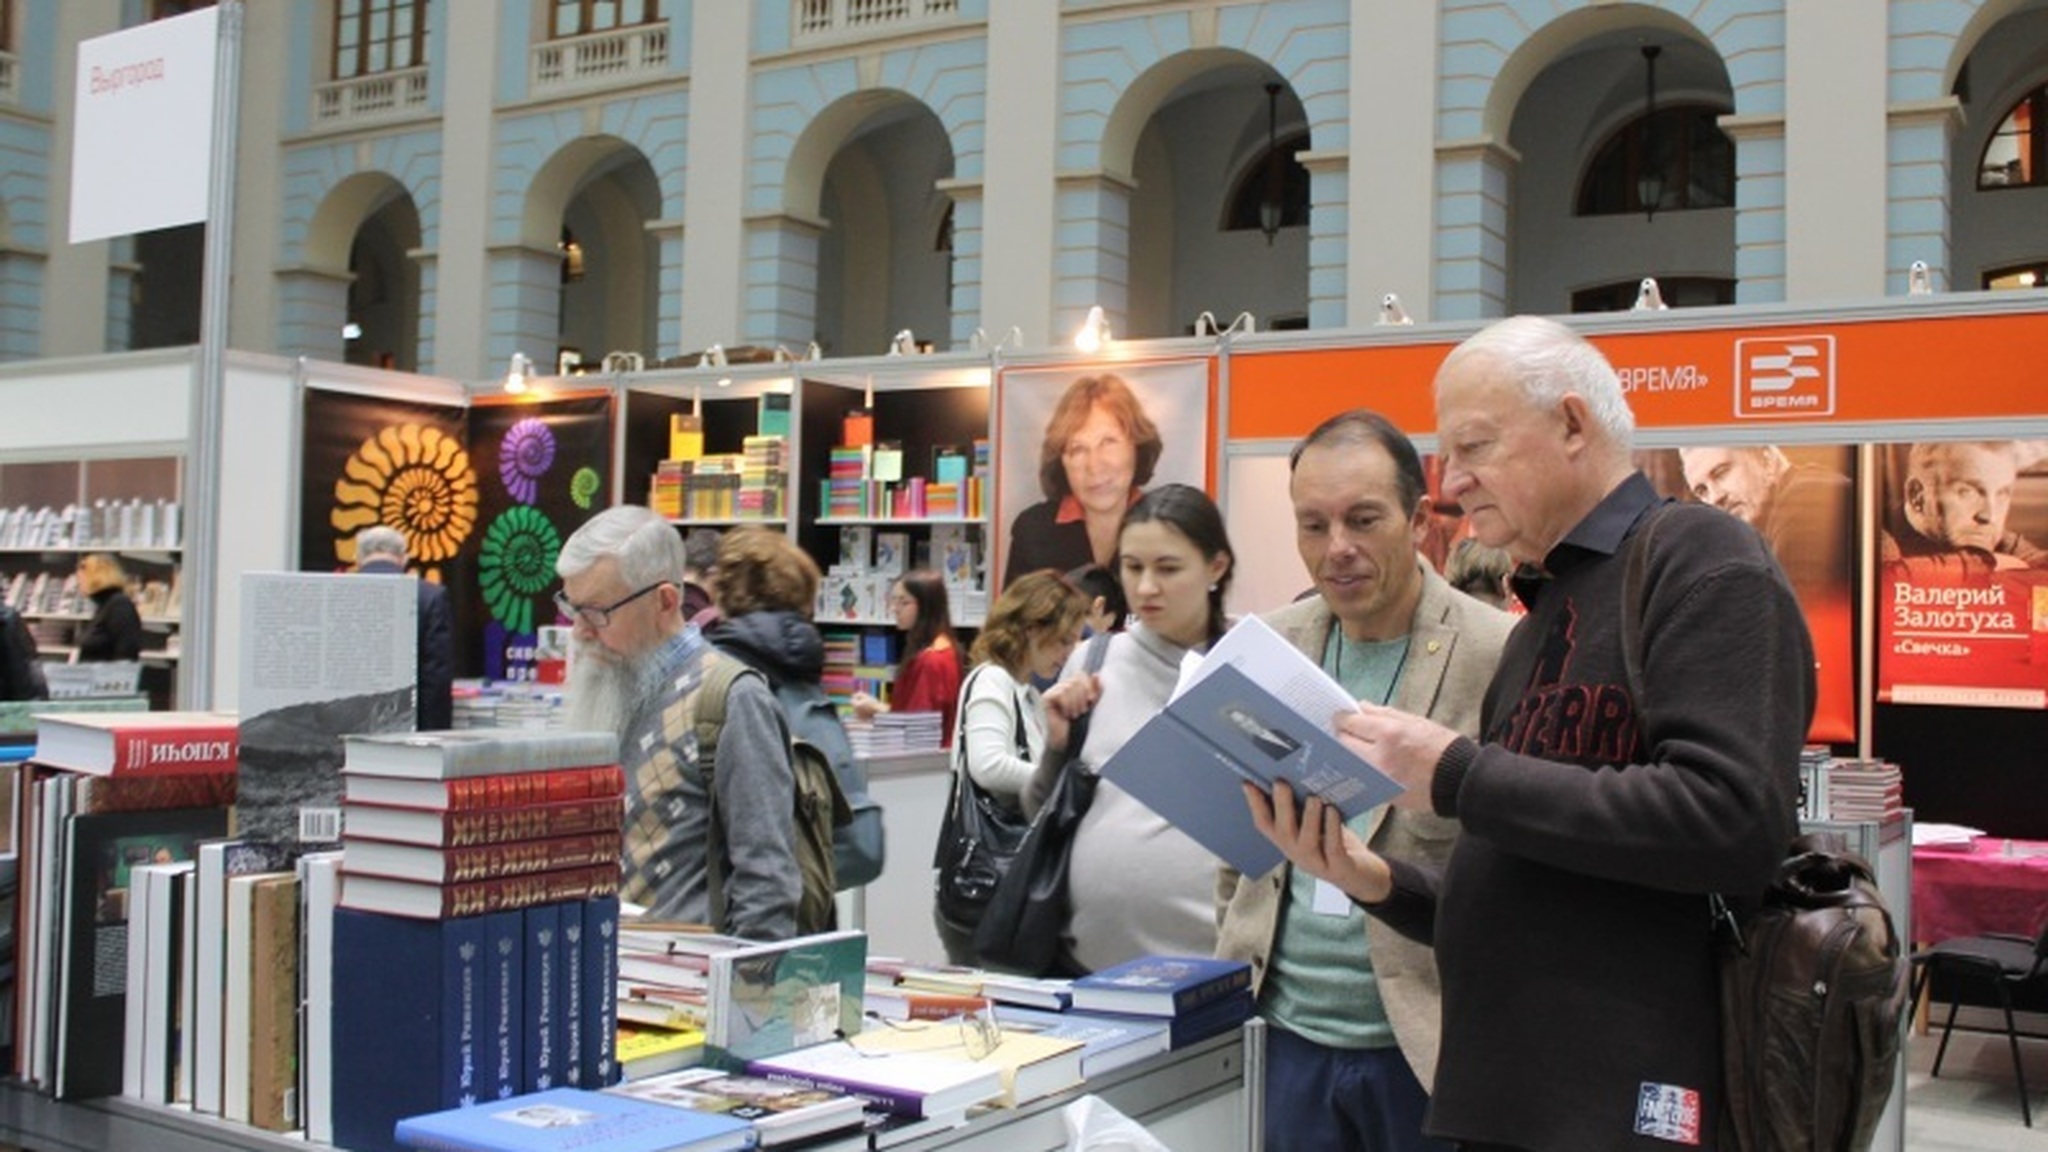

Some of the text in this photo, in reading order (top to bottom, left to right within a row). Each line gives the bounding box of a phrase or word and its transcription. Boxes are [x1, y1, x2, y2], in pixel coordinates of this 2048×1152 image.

[1750, 395, 1819, 408] ВРЕМЯ
[1894, 582, 2005, 610] Валерий
[1894, 606, 2016, 634] Залотуха
[1894, 639, 1971, 656] «Свечка»
